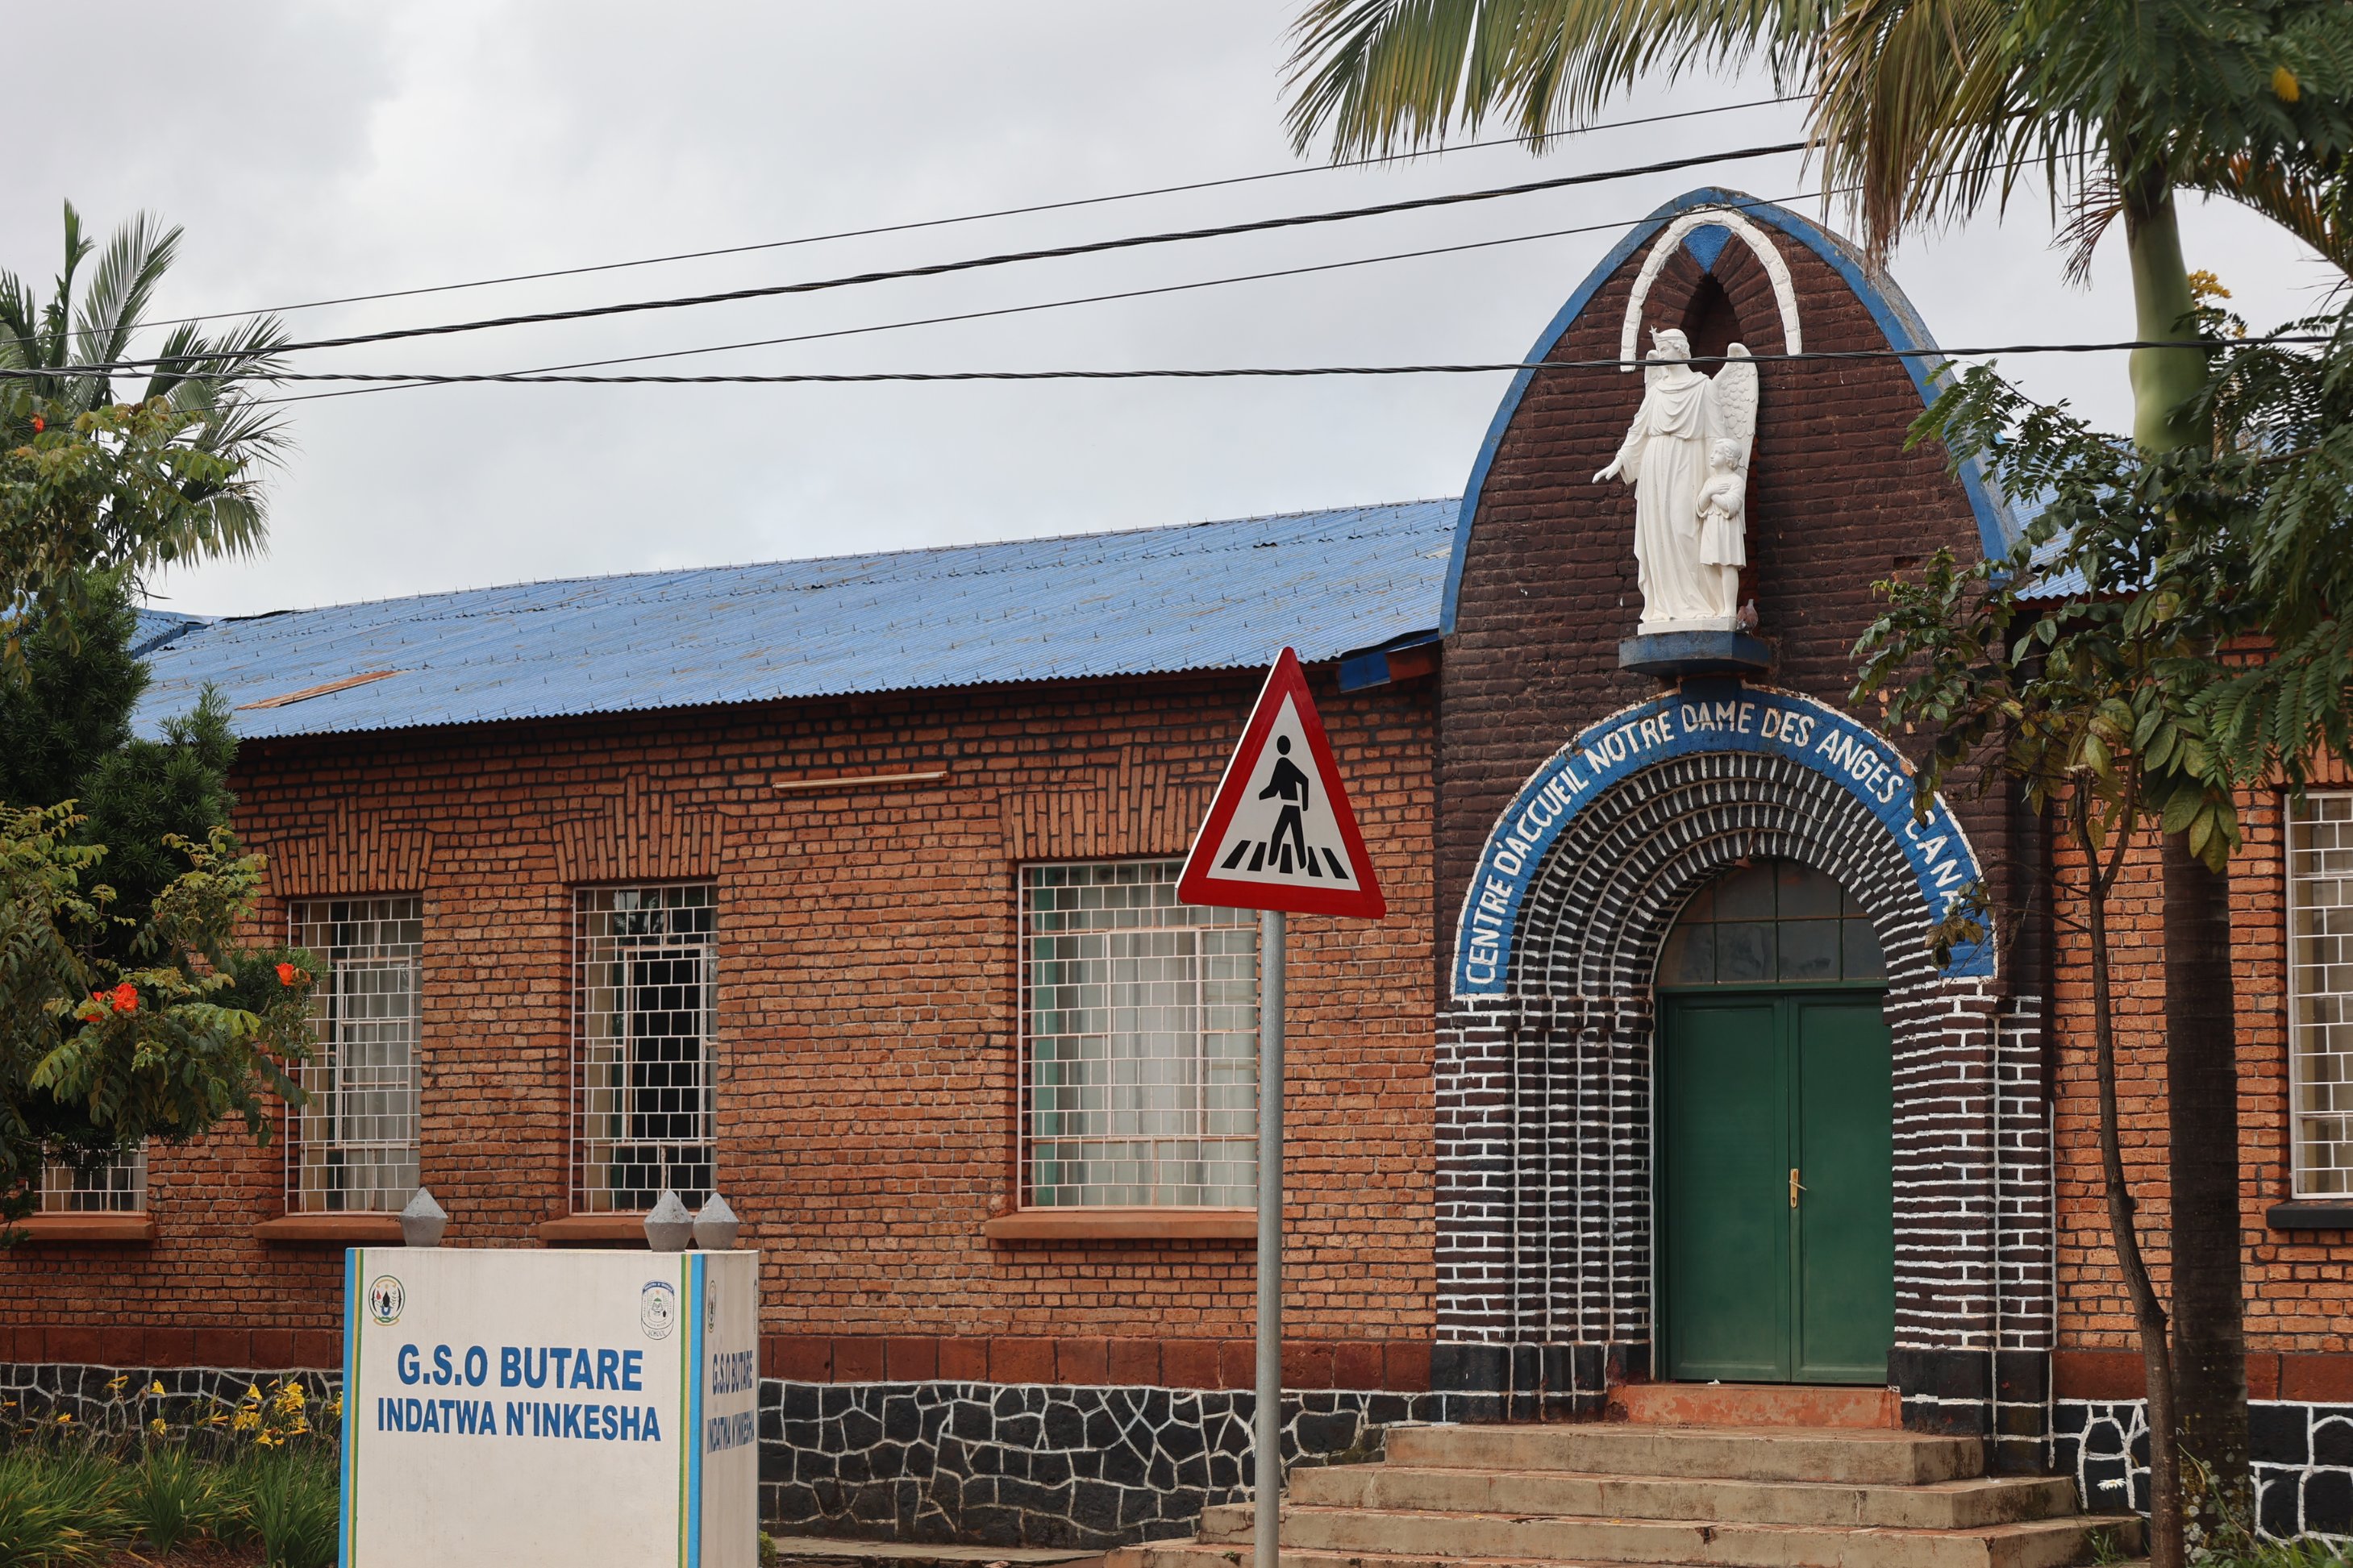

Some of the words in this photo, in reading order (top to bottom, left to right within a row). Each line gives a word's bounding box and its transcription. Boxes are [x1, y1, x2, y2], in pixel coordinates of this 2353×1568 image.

[1466, 874, 1513, 984] CENTRE
[1493, 766, 1589, 876] D'ACCUEIL
[1584, 710, 1676, 775] NOTRE
[1680, 701, 1755, 734] DAME
[1760, 708, 1815, 747] DES
[1815, 729, 1904, 804] ANGES
[398, 1343, 488, 1387] G.S.O
[500, 1346, 643, 1391] BUTARE
[713, 1353, 730, 1395] G.S.O
[731, 1350, 752, 1393] BUTARE
[378, 1397, 497, 1435] INDATWA
[506, 1401, 661, 1441] N'INKESHA
